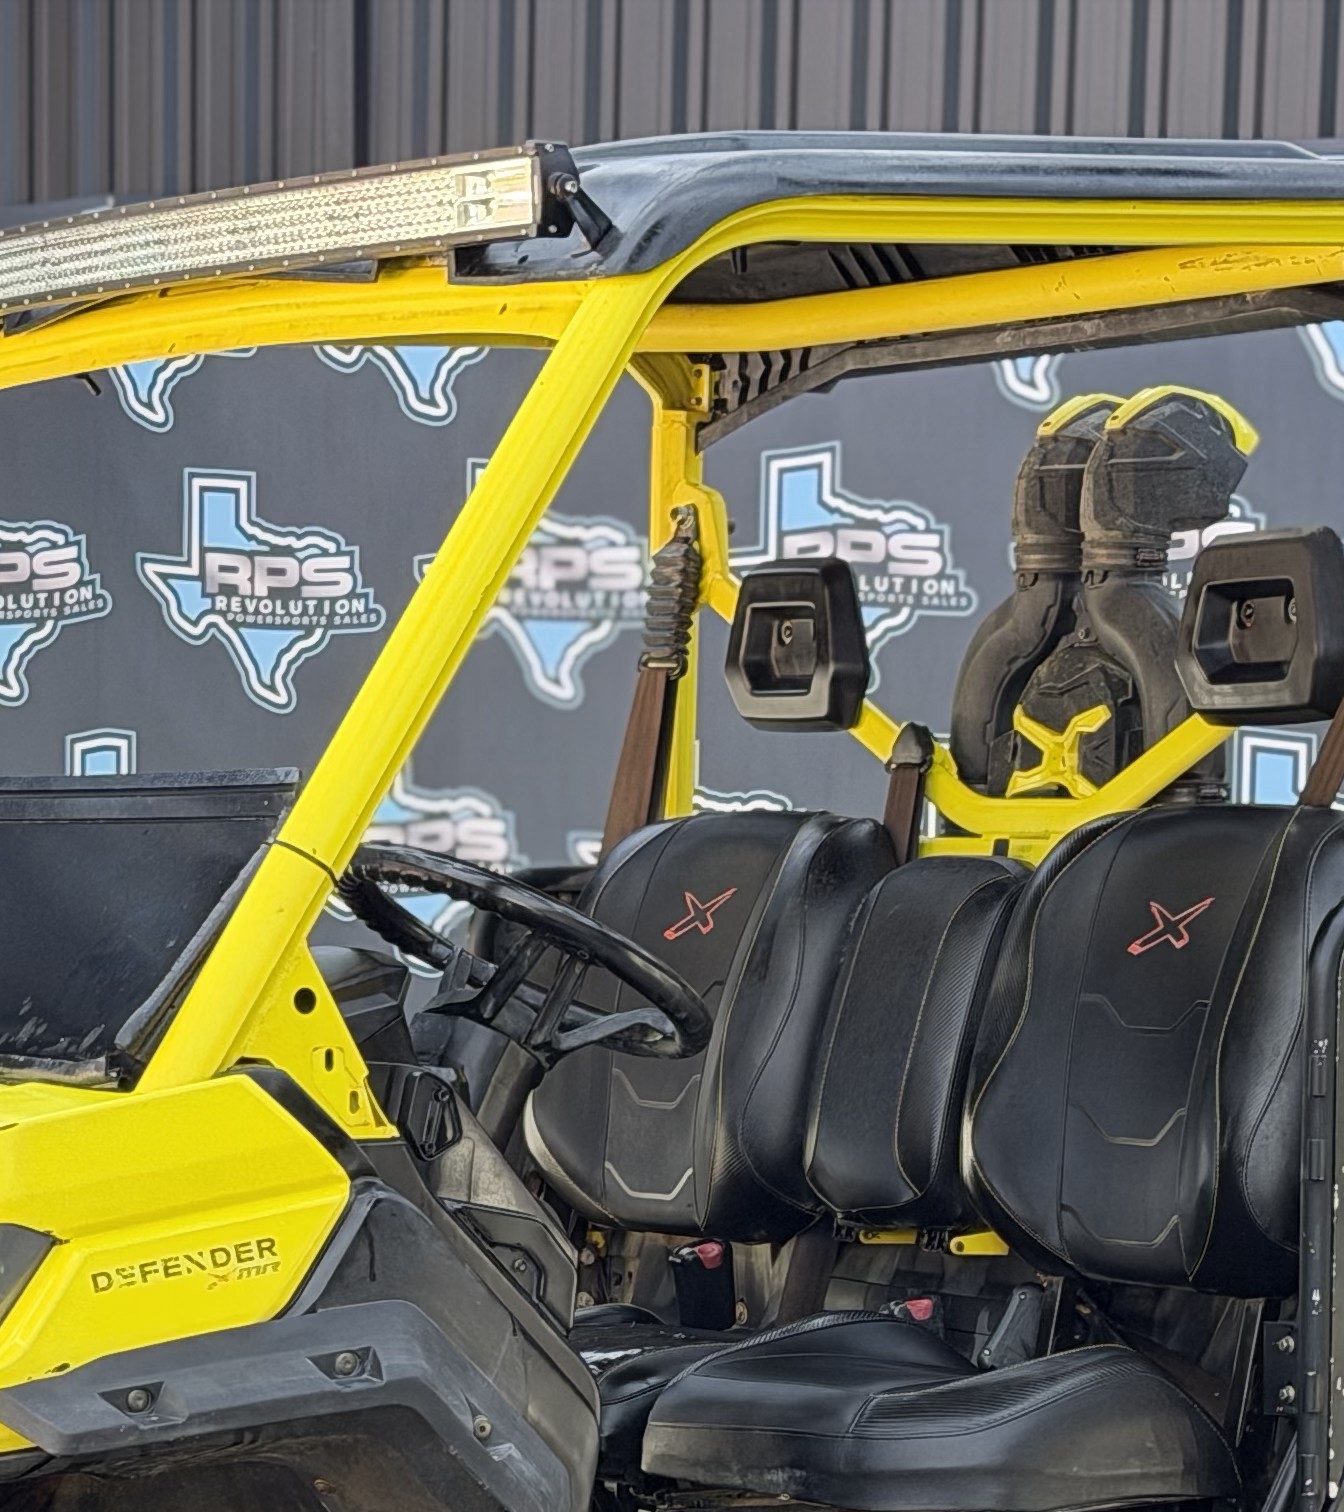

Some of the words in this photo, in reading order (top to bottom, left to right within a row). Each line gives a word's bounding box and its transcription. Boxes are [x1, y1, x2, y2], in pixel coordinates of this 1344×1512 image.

[205, 552, 353, 597] RPS
[858, 575, 955, 595] LUTION
[64, 599, 103, 615] SALES
[214, 596, 365, 615] REVOLUTION
[858, 591, 914, 604] SPORTS
[922, 596, 967, 606] SALES
[226, 613, 327, 625] POWERSPORTS
[334, 613, 377, 625] SALES
[91, 1238, 278, 1293] DEFENDER
